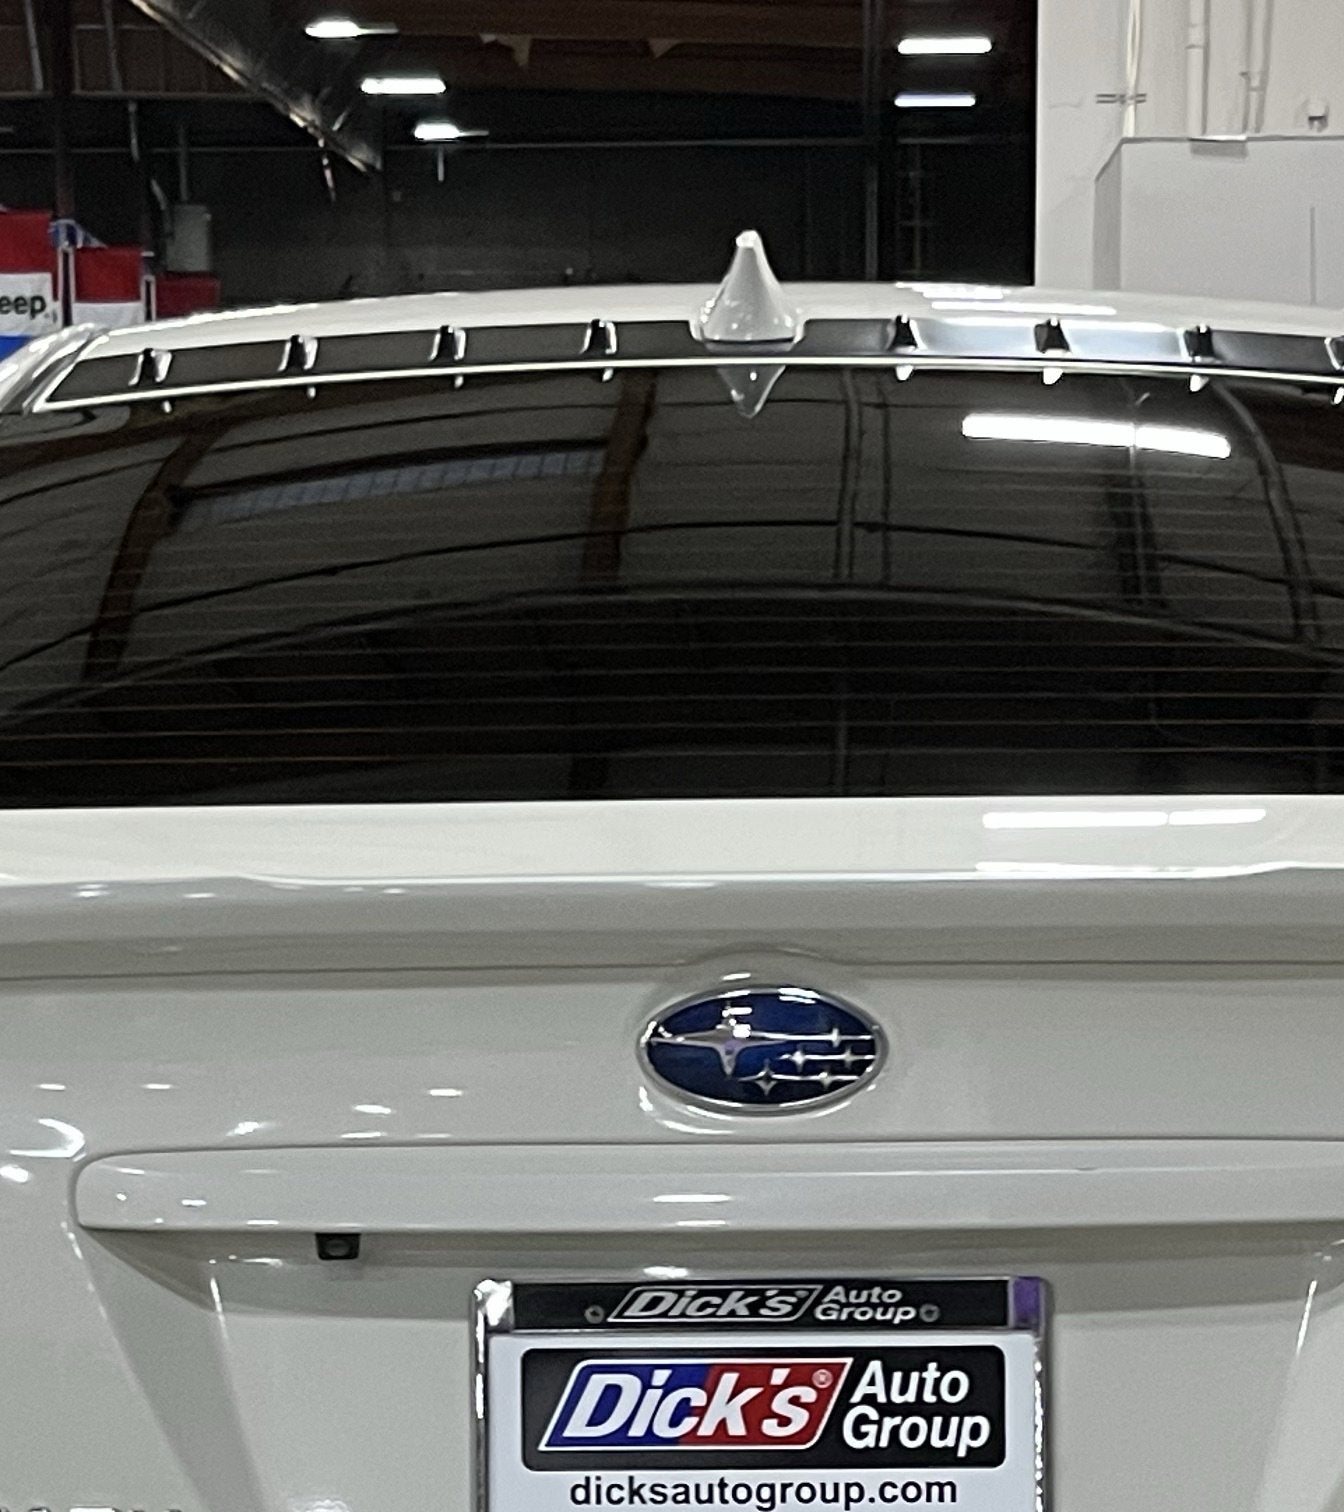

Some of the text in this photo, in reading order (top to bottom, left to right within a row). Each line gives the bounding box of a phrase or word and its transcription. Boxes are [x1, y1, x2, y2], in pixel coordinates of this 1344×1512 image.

[622, 1288, 799, 1317] Dick's
[813, 1303, 917, 1324] Group
[821, 1285, 903, 1305] Auto
[849, 1360, 970, 1404] Auto
[562, 1368, 814, 1438] Dick's
[842, 1405, 992, 1458] Group
[569, 1475, 958, 1512] dicksautogroup.com
